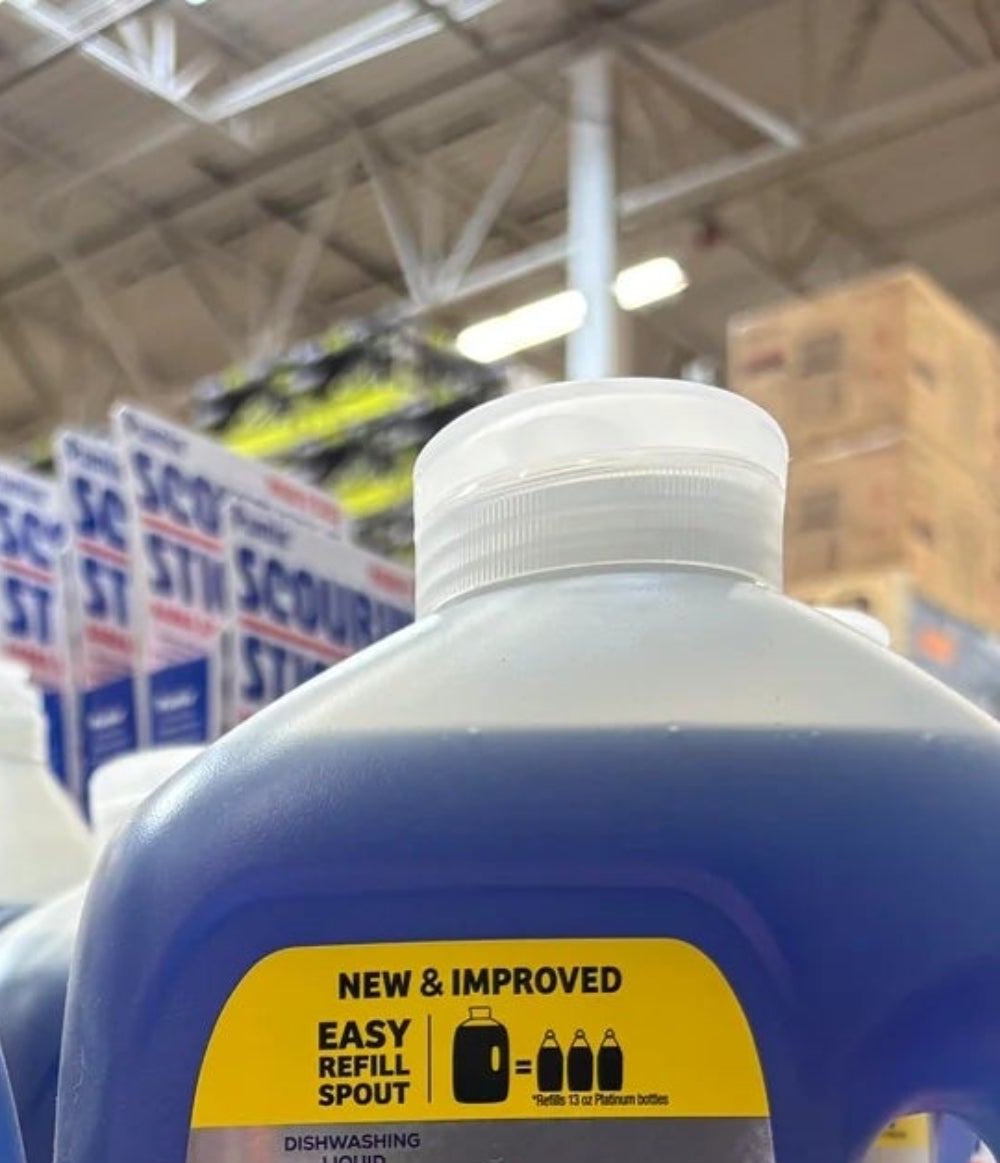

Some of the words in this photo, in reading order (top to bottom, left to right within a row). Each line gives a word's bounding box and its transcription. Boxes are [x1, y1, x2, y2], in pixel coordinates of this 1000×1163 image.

[338, 970, 411, 999] NEW
[420, 969, 444, 997] &
[452, 966, 623, 996] IMPROVED
[317, 1019, 411, 1050] EASY
[318, 1054, 410, 1079] REFILL
[318, 1082, 410, 1106] SPOUT
[568, 1094, 580, 1106] 13
[581, 1096, 593, 1106] oz
[594, 1093, 636, 1106] Platinum
[637, 1093, 669, 1106] bottles
[284, 1132, 421, 1151] DISHWASHING
